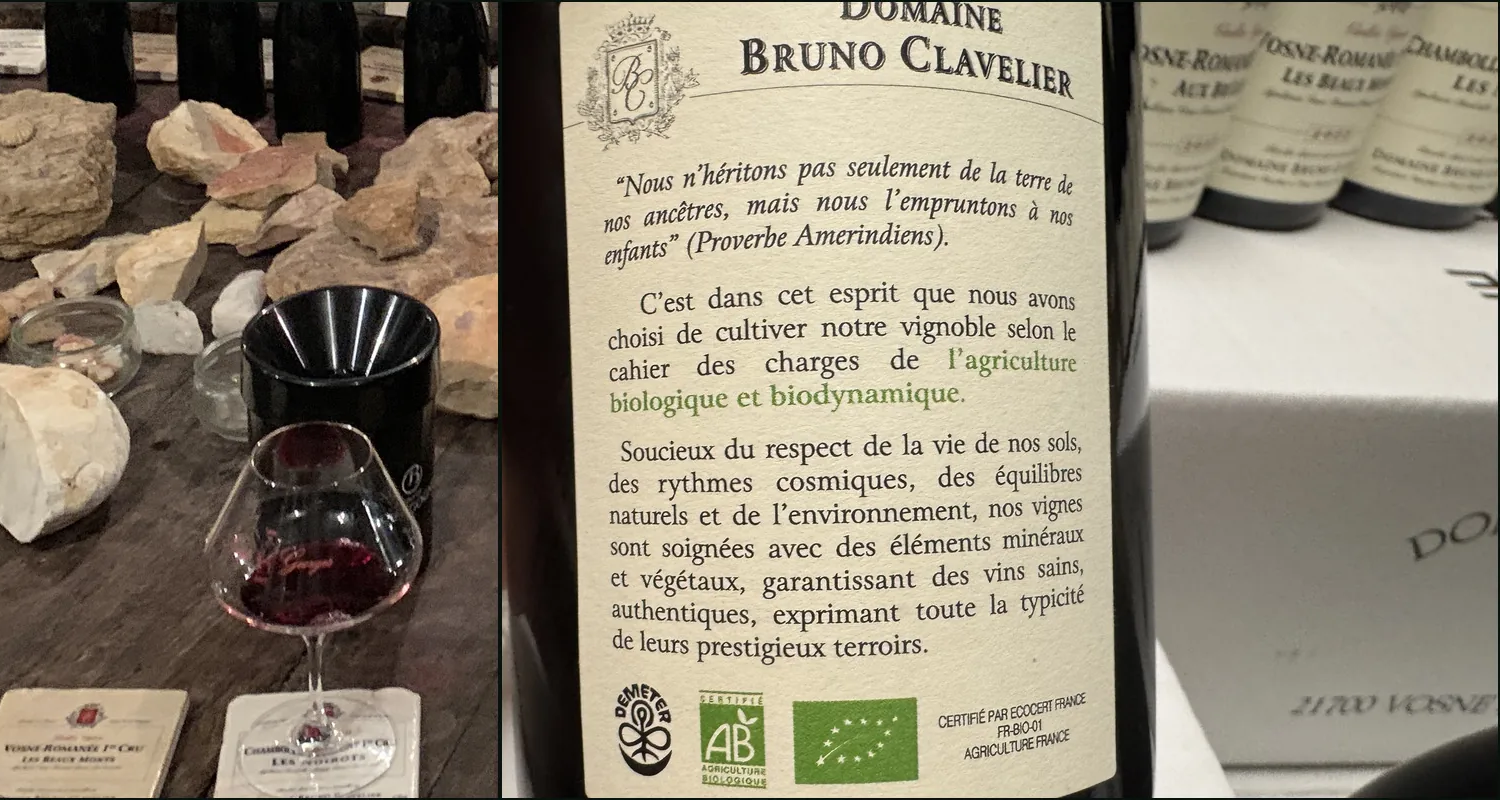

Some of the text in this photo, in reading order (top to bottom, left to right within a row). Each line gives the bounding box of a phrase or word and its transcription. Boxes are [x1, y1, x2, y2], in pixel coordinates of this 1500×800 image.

[739, 35, 1074, 100] BRUNO CLAVELIER
[617, 154, 1073, 197] “Nous n’héritons pas seulement de la terre de
[604, 188, 1073, 233] nos ancêtres, mais nous l’empruntons à nos
[605, 222, 948, 270] enfants” (Proverbe Amerindiens).
[641, 282, 1075, 314] C’est dans cet esprit que nous avons
[609, 315, 1076, 350] choisi de cultiver notre vignoble selon le
[610, 348, 1077, 382] cahier des charges de l’agriculture
[610, 382, 965, 418] biologique et biodynamique.
[622, 431, 1081, 465] Soucieux du respect de la vie de nos sols,
[609, 462, 1082, 501] des rythmes cosmiques, des équilibres
[610, 496, 1082, 526] naturels et de l’environnement, nos vignes
[611, 526, 1084, 565] sont soignées avec des éléments minéraux
[1406, 511, 1498, 562] DO
[611, 557, 1083, 599] et végétaux, garantissant des vins sains,
[612, 584, 1084, 632] authentiques, exprimant toute la typicité
[613, 629, 928, 665] de leurs prestigieux terroirs.
[615, 683, 672, 724] DEMETER
[939, 692, 1086, 728] CERTIFIÉ PAR ECOCERT FRANCE
[705, 723, 755, 763] AB
[964, 729, 1069, 759] AGRICULTURE FRANCE
[998, 719, 1044, 741] FR-BIO-01
[701, 765, 767, 776] AGRICULTURE
[702, 774, 767, 786] BIOLOGIQUE
